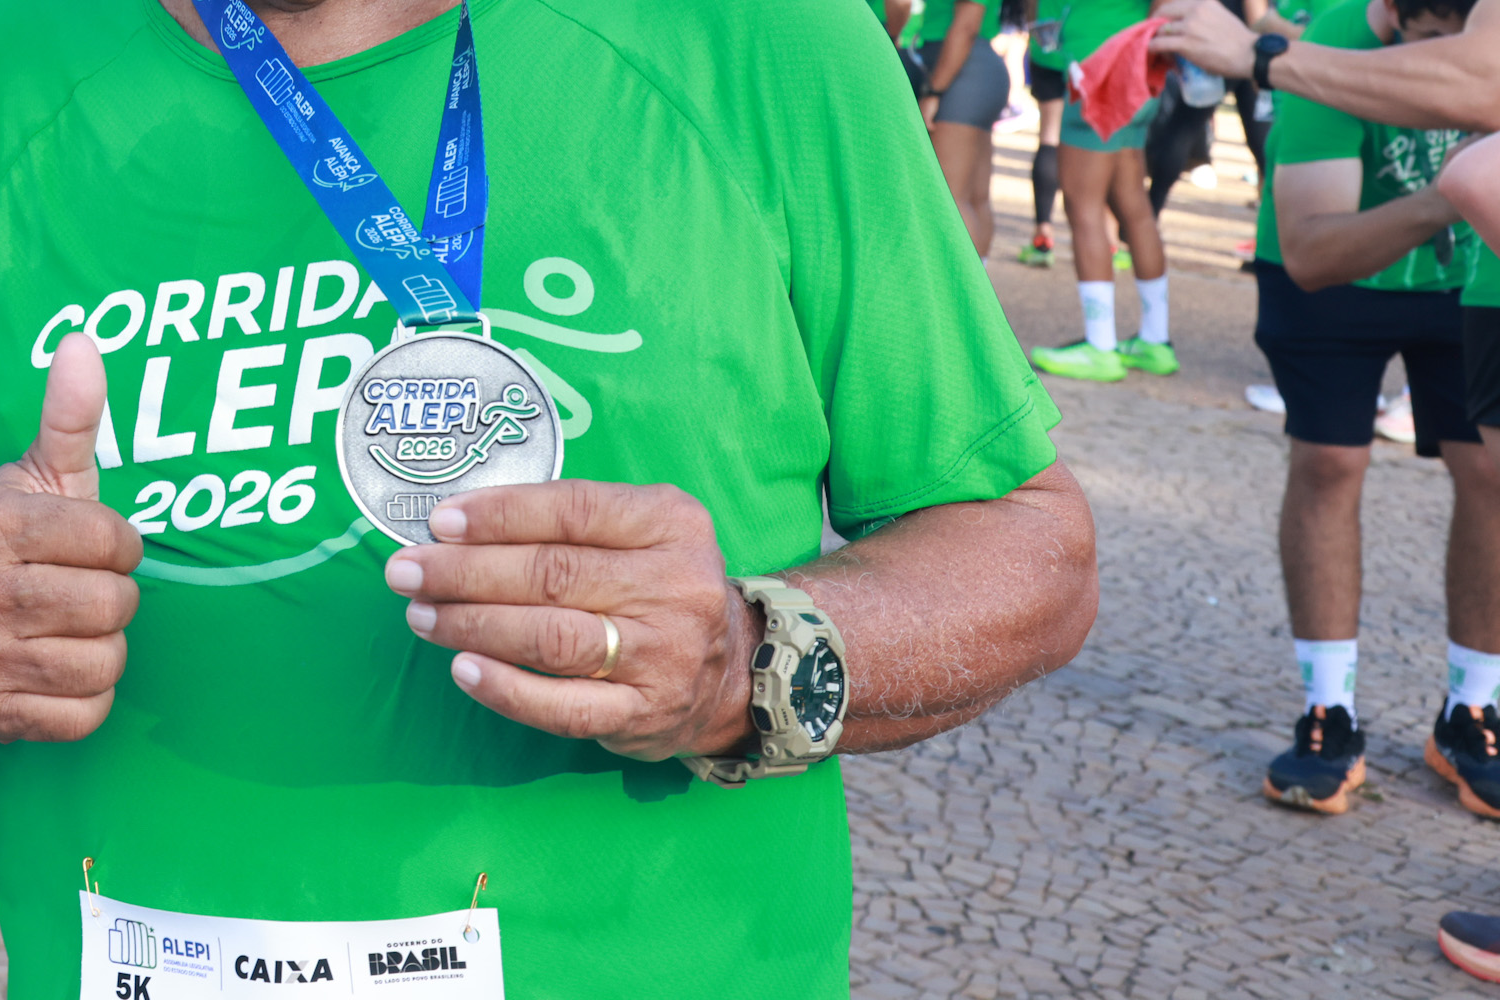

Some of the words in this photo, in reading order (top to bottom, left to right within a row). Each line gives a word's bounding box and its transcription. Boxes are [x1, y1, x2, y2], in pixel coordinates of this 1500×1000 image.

[224, 3, 251, 38] ALEPI
[224, 23, 237, 41] 2026
[293, 91, 315, 121] ALEPI
[324, 156, 349, 181] ALEPI
[443, 137, 458, 171] ALEPI
[364, 227, 384, 244] 2026
[371, 214, 409, 247] ALEPI
[389, 206, 421, 243] CORRIDA
[95, 328, 414, 469] LEP
[366, 380, 478, 401] CORRIDA
[370, 402, 477, 431] ALEPI
[400, 439, 453, 457] 2026
[127, 465, 317, 536] 2026
[162, 937, 210, 961] ALEPI
[387, 939, 427, 948] GOVERNO
[235, 955, 334, 984] CAIXA
[368, 946, 467, 976] BRASIL
[116, 971, 152, 1000] 5K
